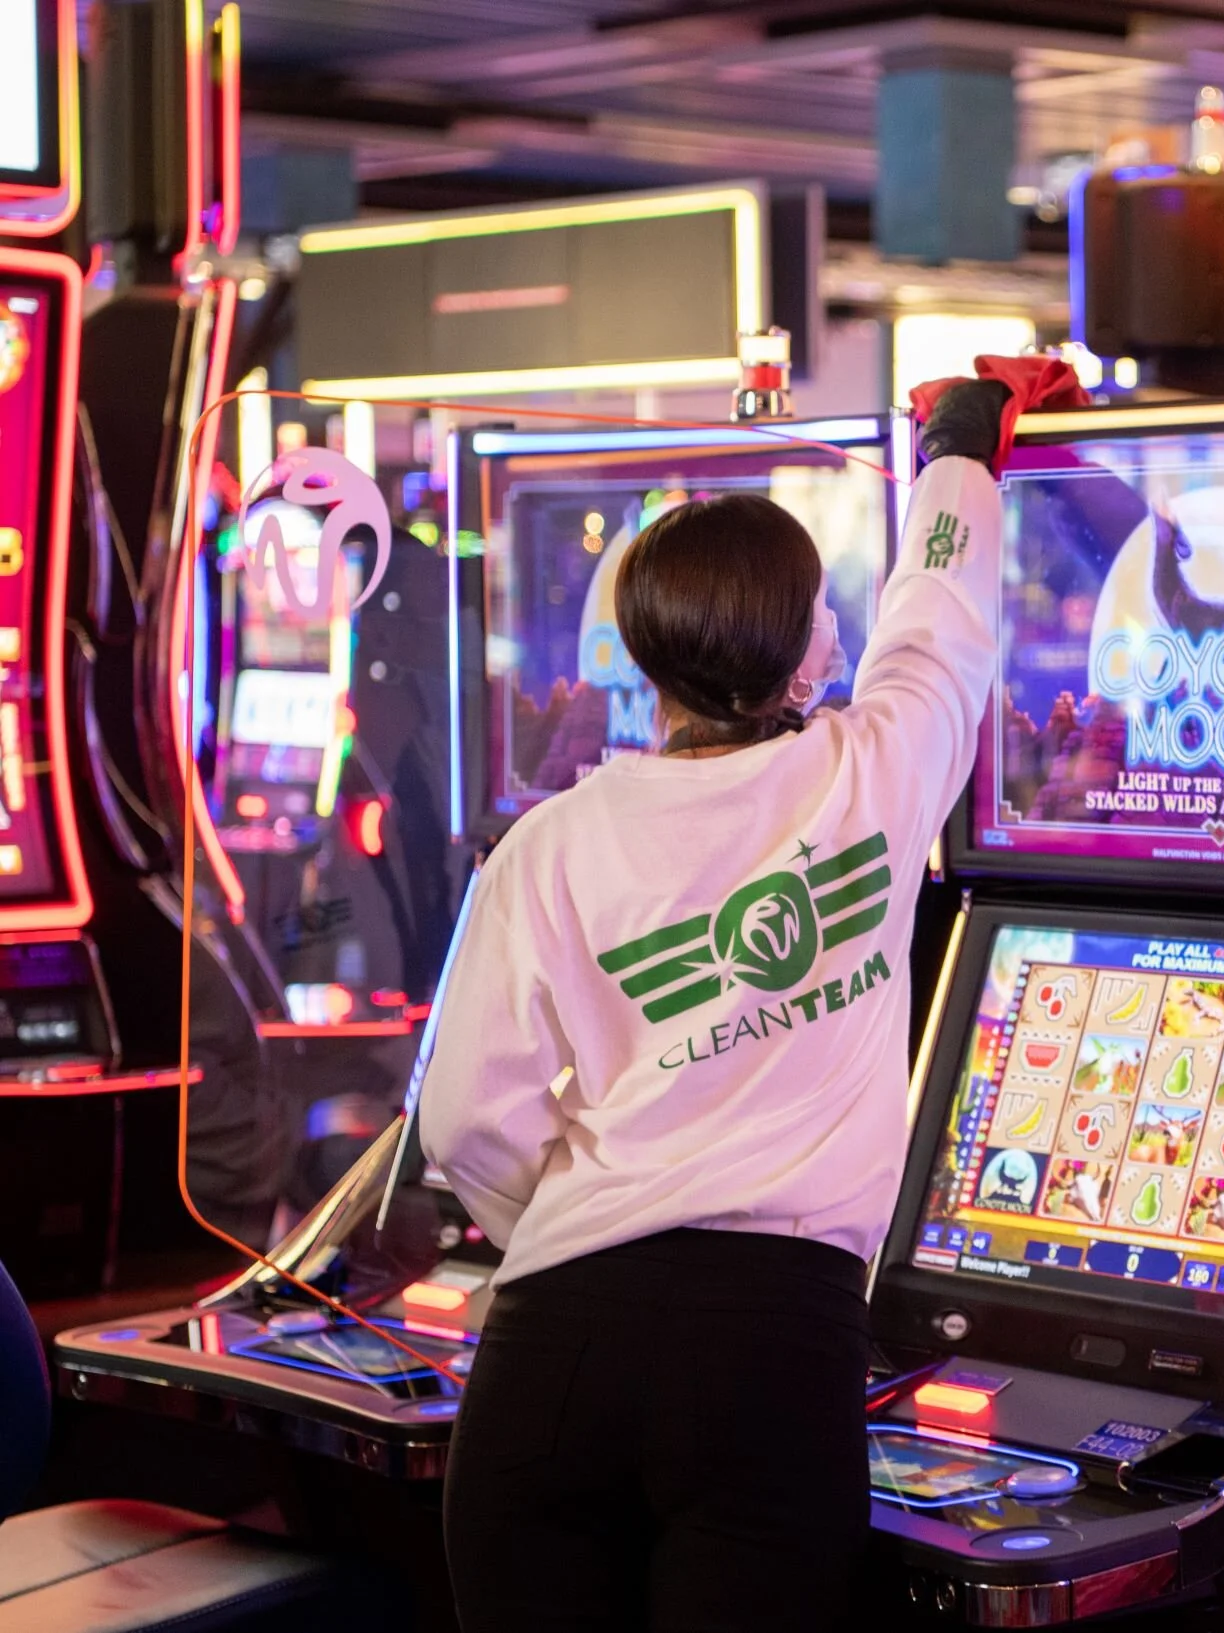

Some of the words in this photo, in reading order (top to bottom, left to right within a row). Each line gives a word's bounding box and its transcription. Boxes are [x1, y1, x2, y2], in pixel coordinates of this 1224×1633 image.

[1118, 771, 1169, 794] LIGHT
[1173, 776, 1192, 792] UP
[1193, 777, 1222, 793] THE
[1085, 790, 1159, 812] STACKED
[1163, 793, 1217, 815] WILDS
[1148, 941, 1183, 955] PLAY
[1184, 944, 1211, 958] ALL
[1131, 954, 1162, 968] FOR
[960, 1255, 997, 1273] Welcome
[1104, 1422, 1160, 1442] 102003
